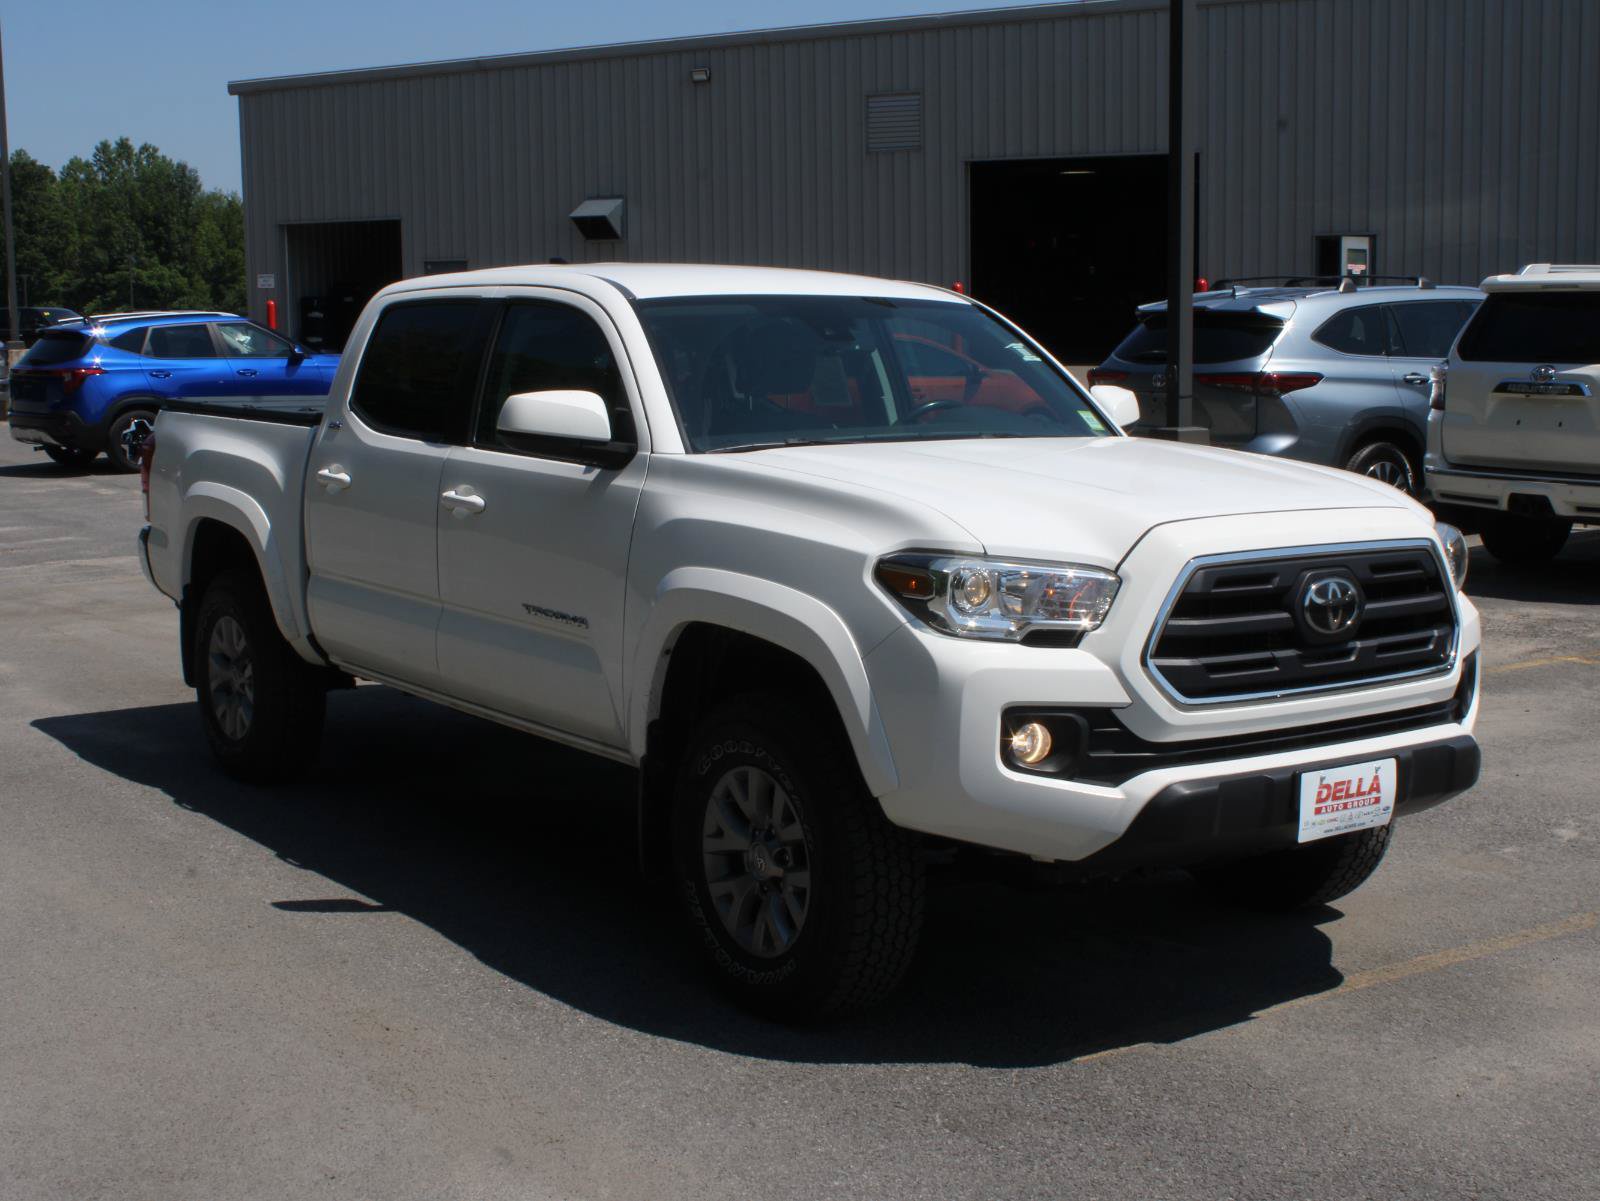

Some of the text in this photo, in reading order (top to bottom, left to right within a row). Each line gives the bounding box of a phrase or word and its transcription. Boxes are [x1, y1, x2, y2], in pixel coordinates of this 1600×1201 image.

[1315, 775, 1381, 804] DELLA
[1321, 797, 1376, 814] AUTO GROUP
